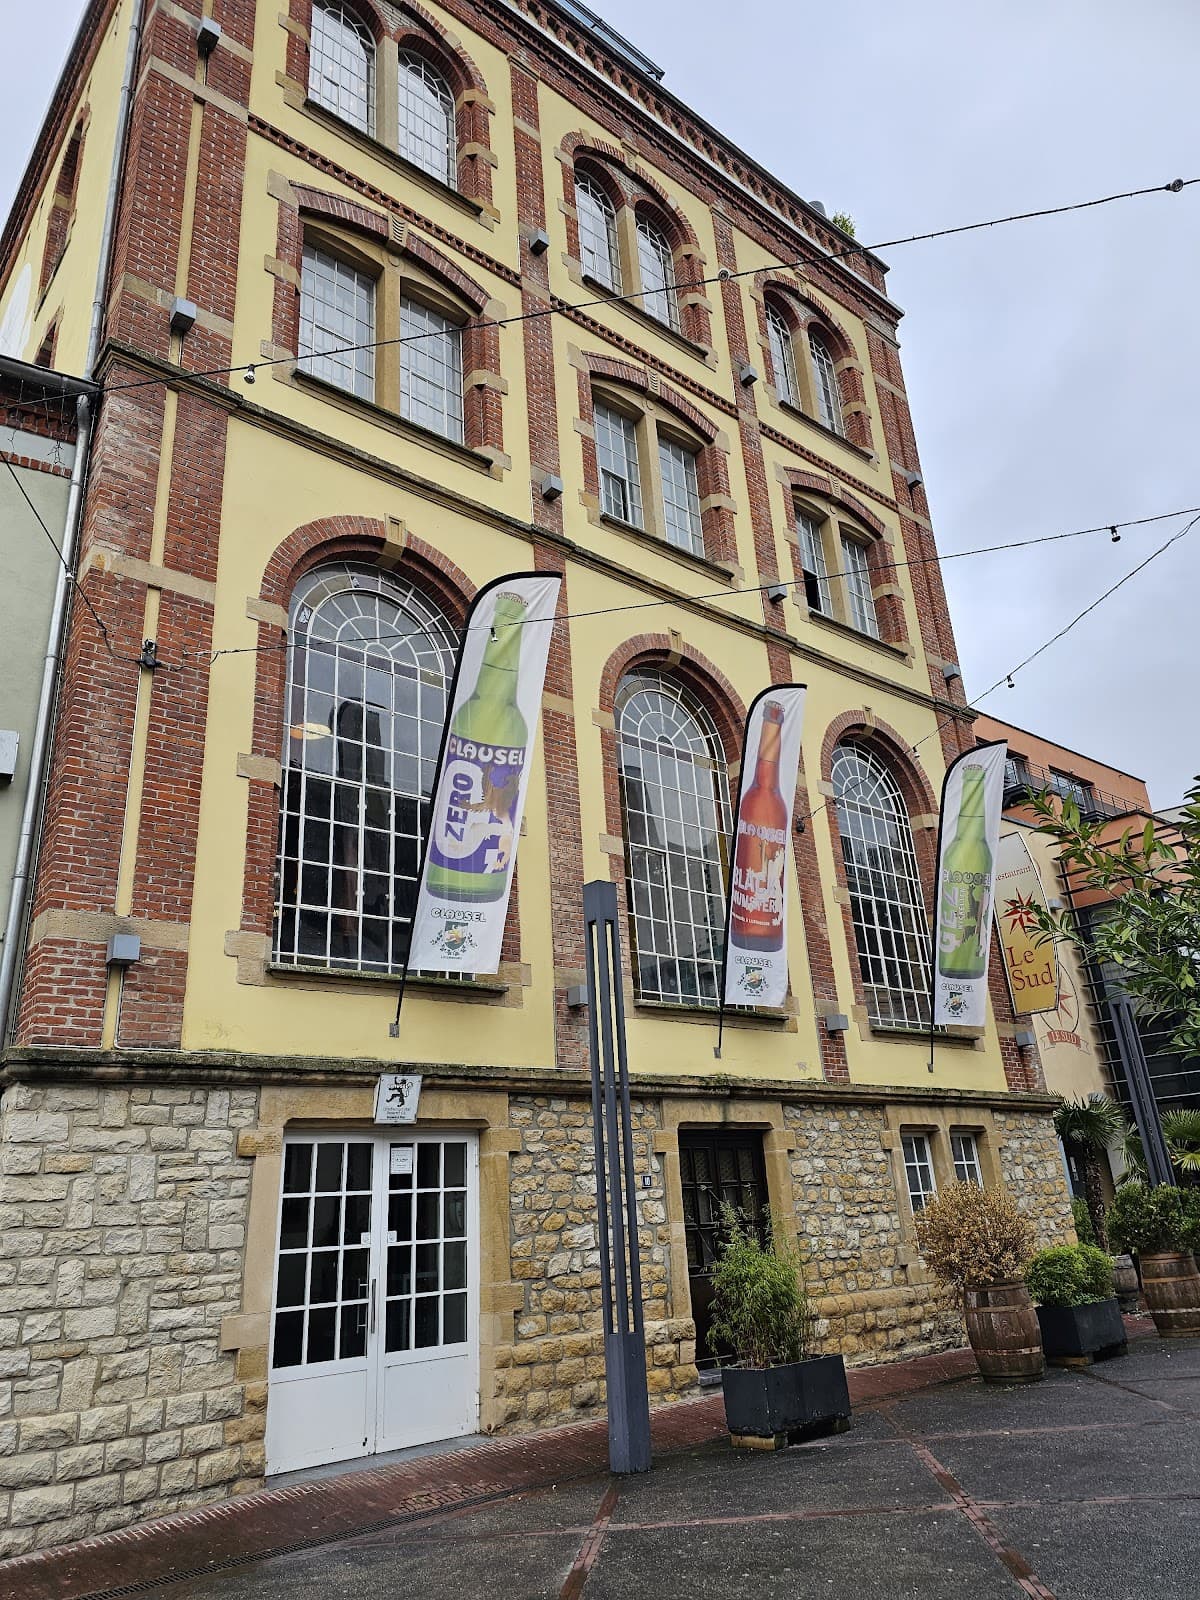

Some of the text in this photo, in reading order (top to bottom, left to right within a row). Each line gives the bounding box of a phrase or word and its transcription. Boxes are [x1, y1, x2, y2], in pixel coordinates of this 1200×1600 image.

[449, 736, 525, 766] CLAUSEL
[444, 772, 474, 842] ZERO
[995, 865, 1031, 881] estaurant
[430, 906, 487, 923] CLAUSEL
[735, 955, 774, 968] CLAUSEL
[1005, 945, 1035, 968] Le
[1011, 962, 1055, 991] Sud
[941, 982, 974, 993] CLAUSEL
